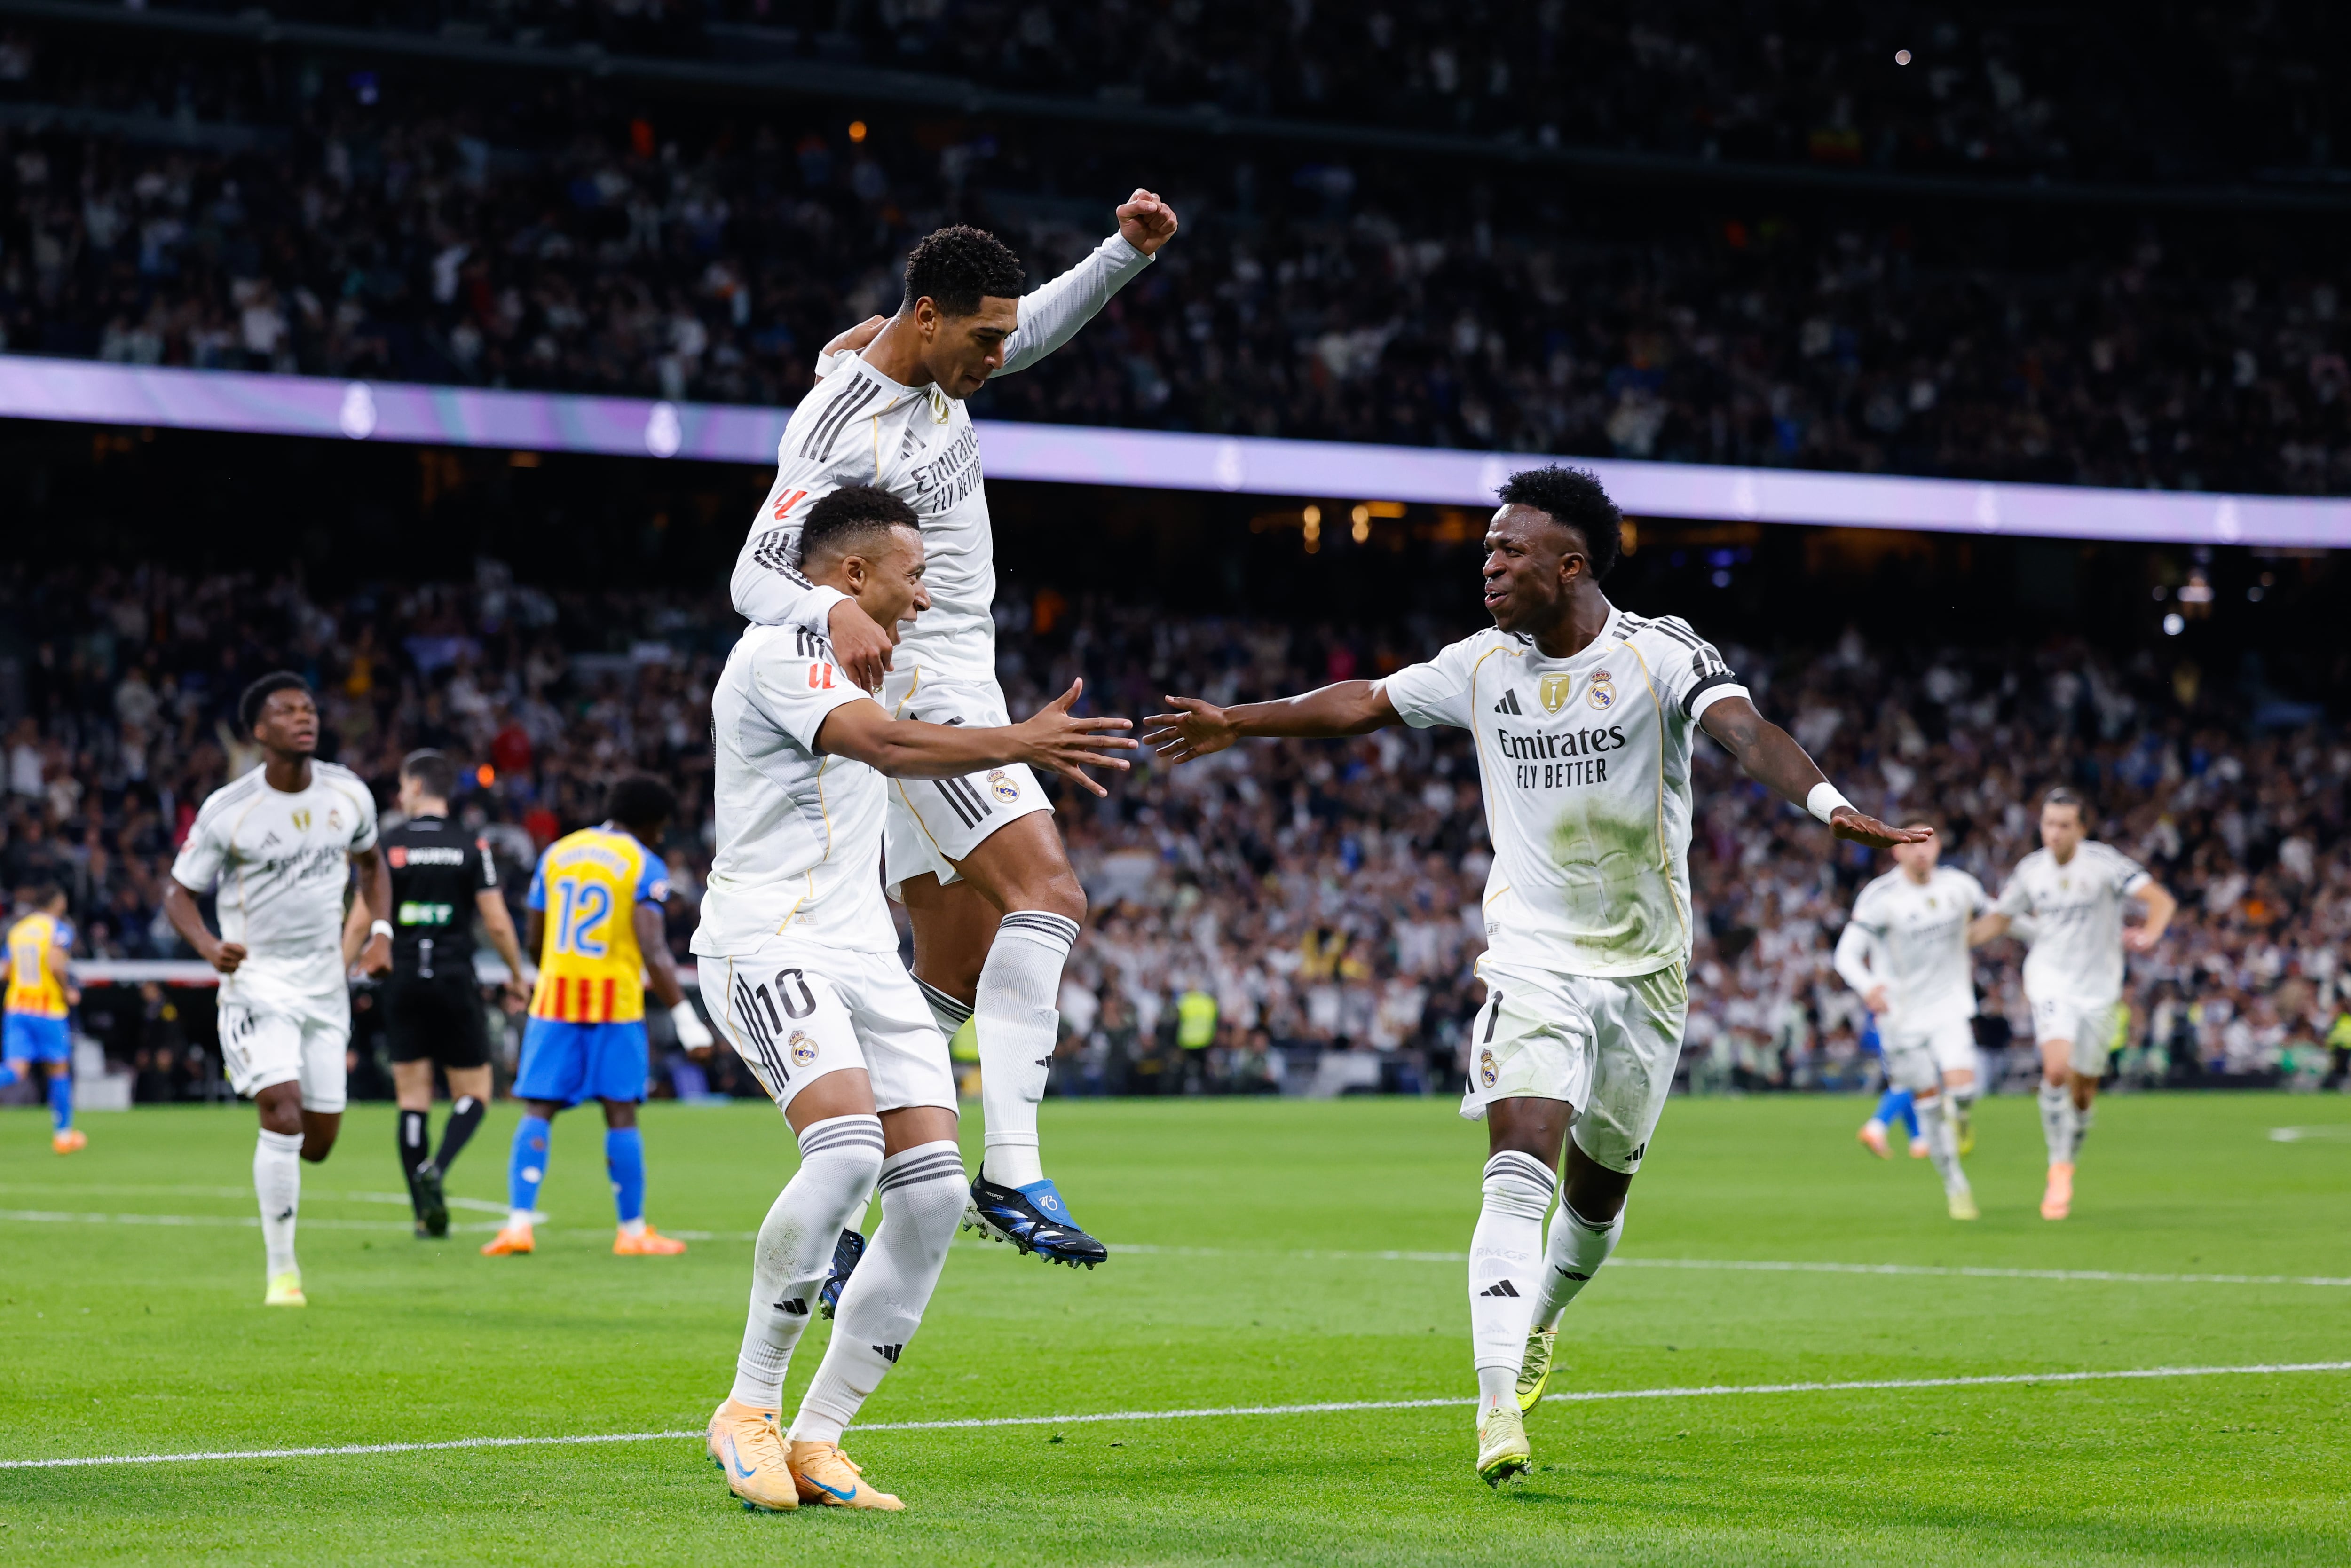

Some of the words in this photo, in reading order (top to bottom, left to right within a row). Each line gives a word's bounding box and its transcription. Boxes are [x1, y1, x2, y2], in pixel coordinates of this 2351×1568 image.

[910, 425, 978, 495] Emirates
[932, 482, 953, 513] FLY
[956, 455, 982, 502] BETTER
[1498, 725, 1625, 759] Emirates
[1517, 765, 1537, 789] FLY
[1545, 758, 1608, 789] BETTER
[558, 878, 612, 957] 12
[756, 968, 816, 1036] 10
[985, 1190, 1004, 1199] PREDATOR
